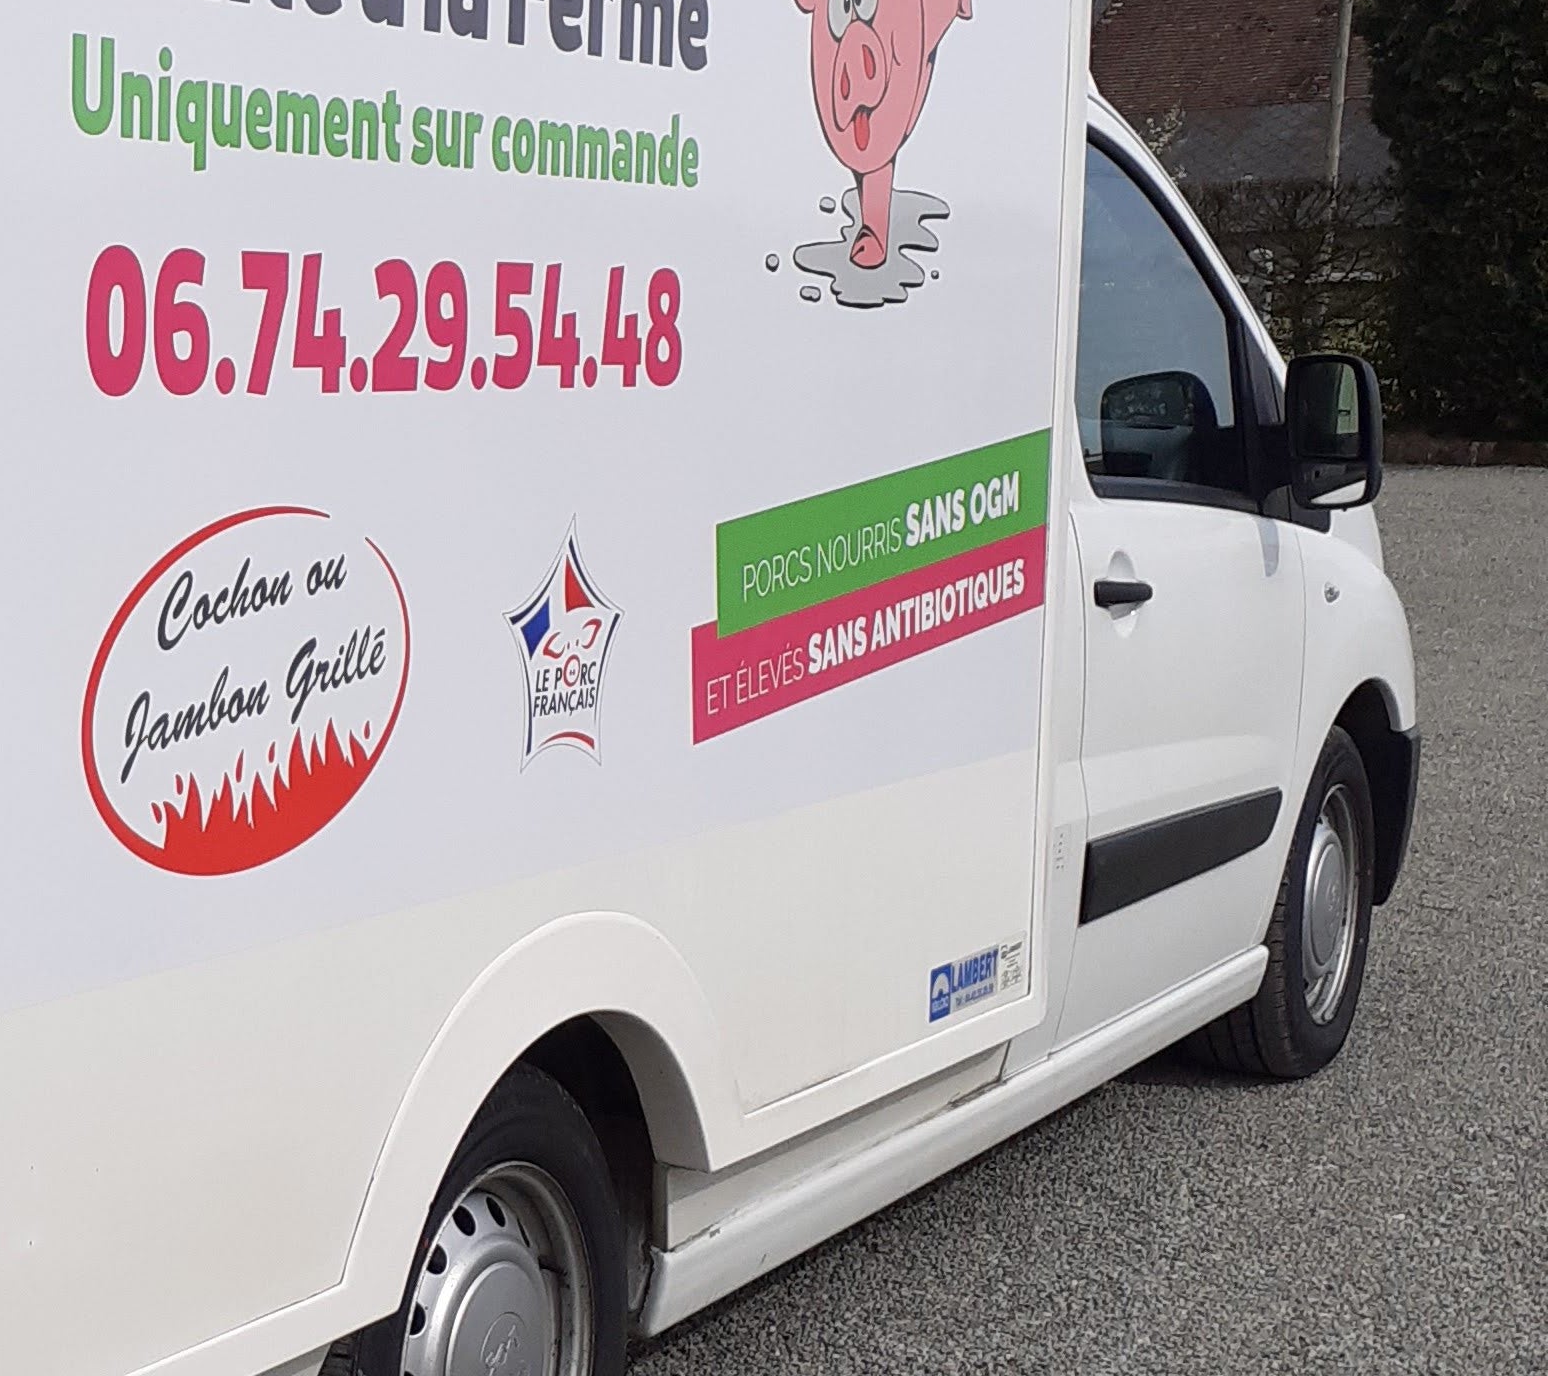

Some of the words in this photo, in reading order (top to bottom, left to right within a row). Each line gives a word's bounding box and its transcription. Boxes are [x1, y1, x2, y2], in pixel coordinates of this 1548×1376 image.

[72, 33, 401, 171] Uniquement
[412, 108, 483, 169] sur
[491, 113, 699, 188] commande
[86, 245, 683, 397] 06.74.29.54.48
[157, 557, 293, 651] Cochon
[306, 553, 348, 596] ou
[743, 546, 812, 603] PORCS
[816, 518, 902, 578] NOURRIS
[906, 488, 966, 548] SANS
[970, 470, 1020, 525] OGM
[533, 686, 596, 717] FRANÇAIS
[535, 668, 550, 693] LE
[554, 654, 596, 690] PORC
[707, 674, 731, 715] ET
[736, 643, 804, 704] ÉLEVÉS
[808, 616, 868, 675] SANS
[871, 558, 1026, 652] ANTIBIOTIQUES
[120, 665, 270, 784] Jambon
[285, 625, 386, 725] Grillé
[951, 947, 999, 994] LAMBERT
